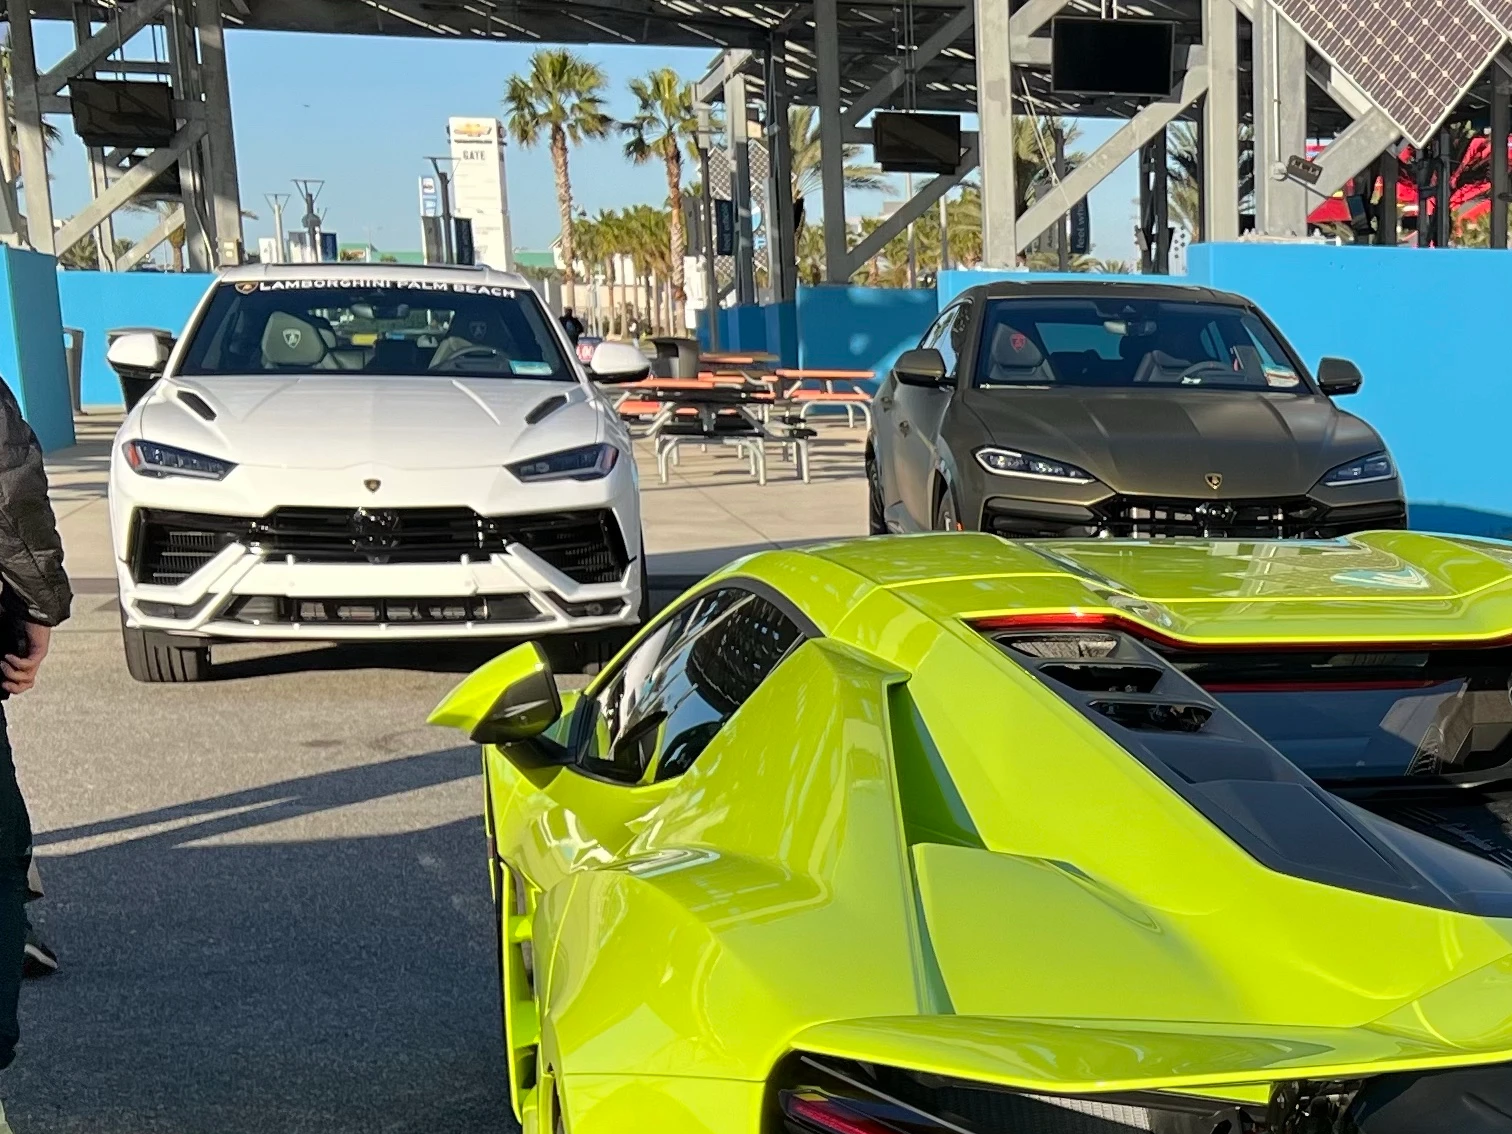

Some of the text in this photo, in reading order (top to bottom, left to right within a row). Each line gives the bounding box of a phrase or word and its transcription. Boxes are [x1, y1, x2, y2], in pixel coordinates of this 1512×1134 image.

[462, 150, 486, 161] GATE
[259, 280, 516, 298] LAMBORGHINI PALM BEACH
